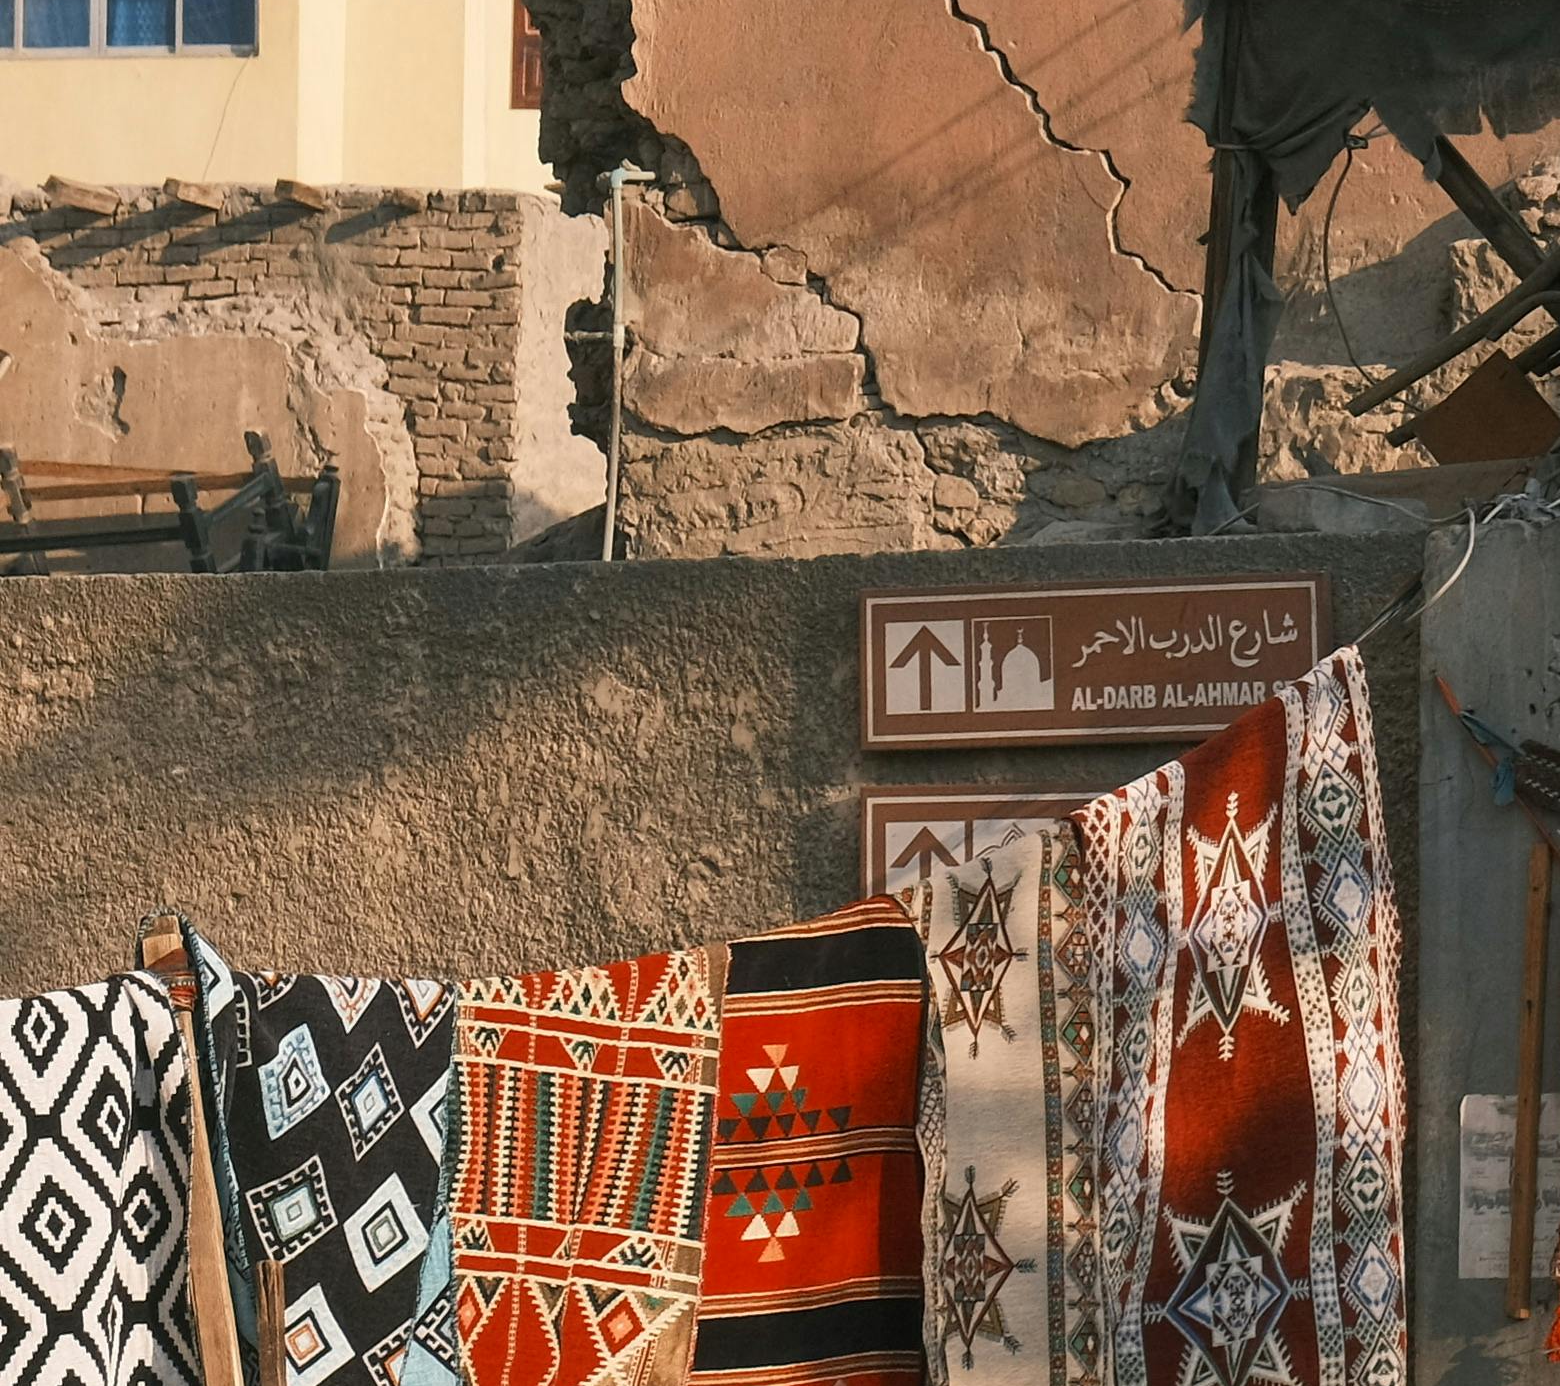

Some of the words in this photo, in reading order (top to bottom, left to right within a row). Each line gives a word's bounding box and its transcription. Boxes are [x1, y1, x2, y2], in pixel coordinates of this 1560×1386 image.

[1071, 614, 1146, 668] الاحمر
[1148, 614, 1225, 659] الدرب
[1230, 608, 1300, 668] شارع
[1071, 683, 1157, 712] AL-DARB
[1162, 681, 1267, 709] AL-AHMAR
